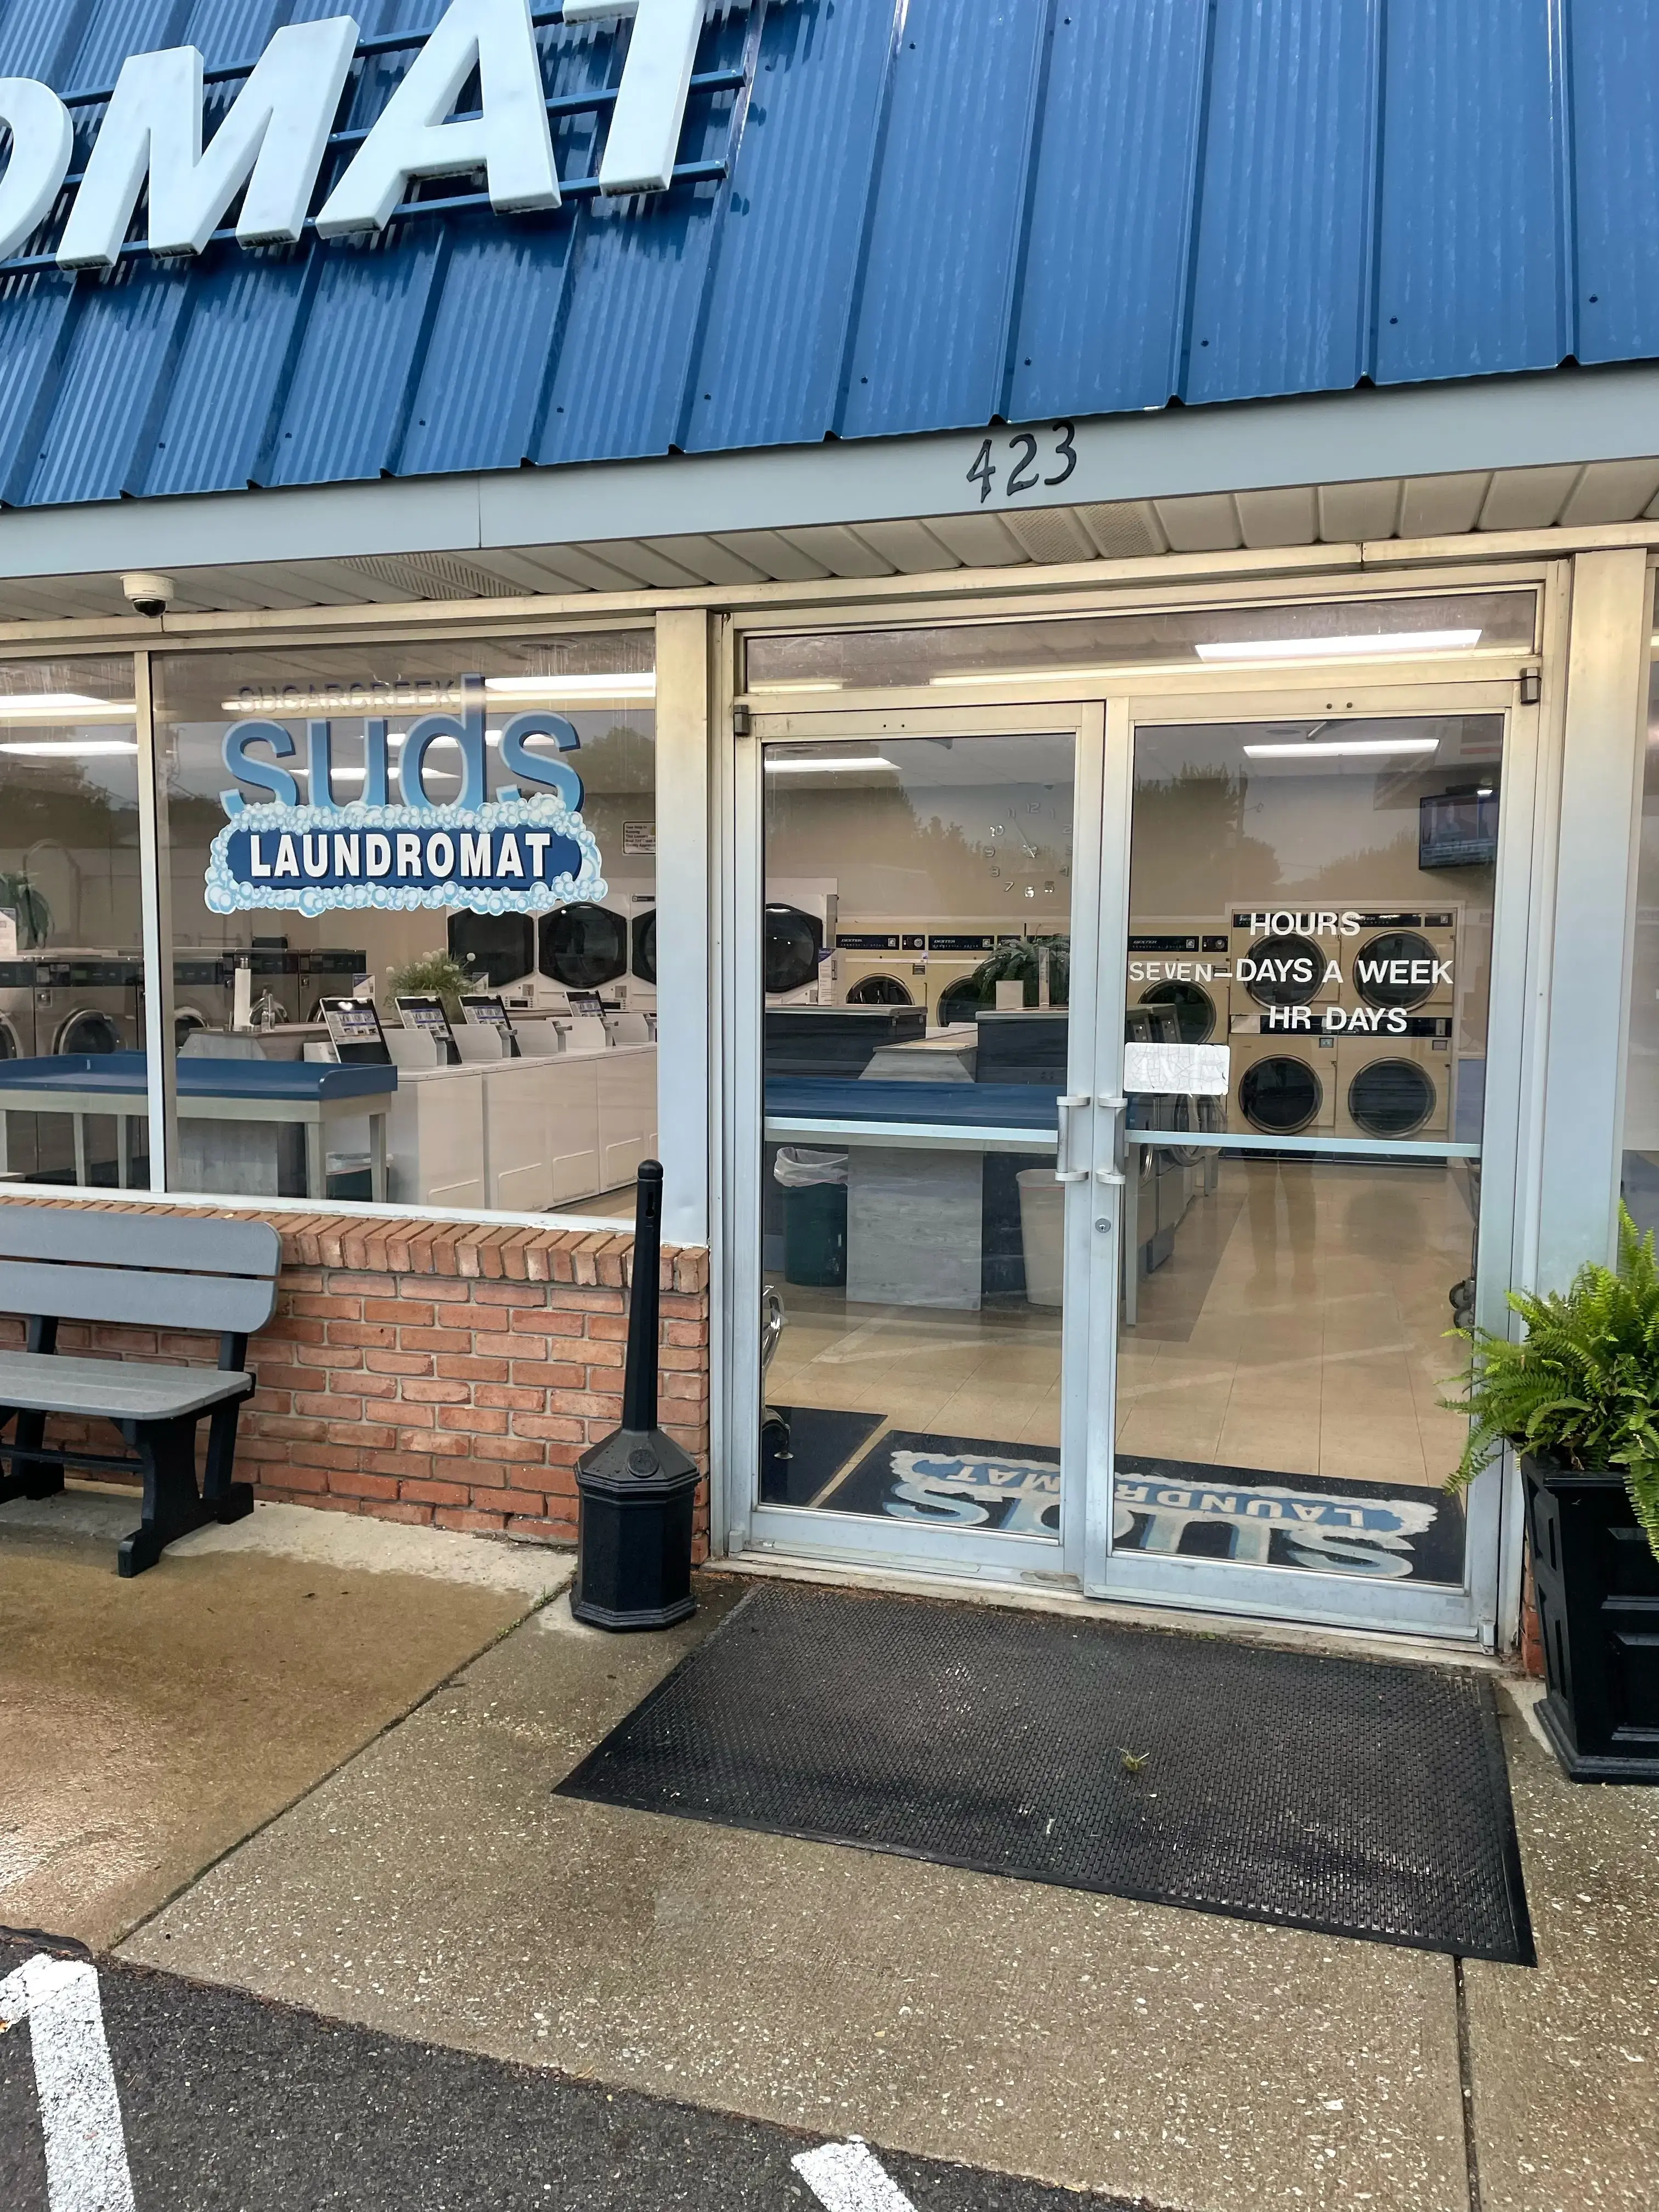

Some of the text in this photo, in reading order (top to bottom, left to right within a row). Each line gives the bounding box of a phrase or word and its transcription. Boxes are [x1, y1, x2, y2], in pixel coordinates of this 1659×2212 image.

[966, 420, 1077, 503] 423
[238, 680, 455, 713] SUGARCREEK
[219, 673, 585, 821] suds
[990, 825, 1005, 837] 10
[249, 832, 552, 879] LAUNDROMAT
[991, 866, 1000, 877] 8
[1003, 881, 1014, 892] 7
[1024, 885, 1035, 898] 6
[1044, 881, 1054, 893] 5
[1250, 911, 1361, 936] HOURS
[1322, 960, 1344, 983] A
[1358, 960, 1454, 984] WEEK
[1269, 1006, 1407, 1032] HR DAYS
